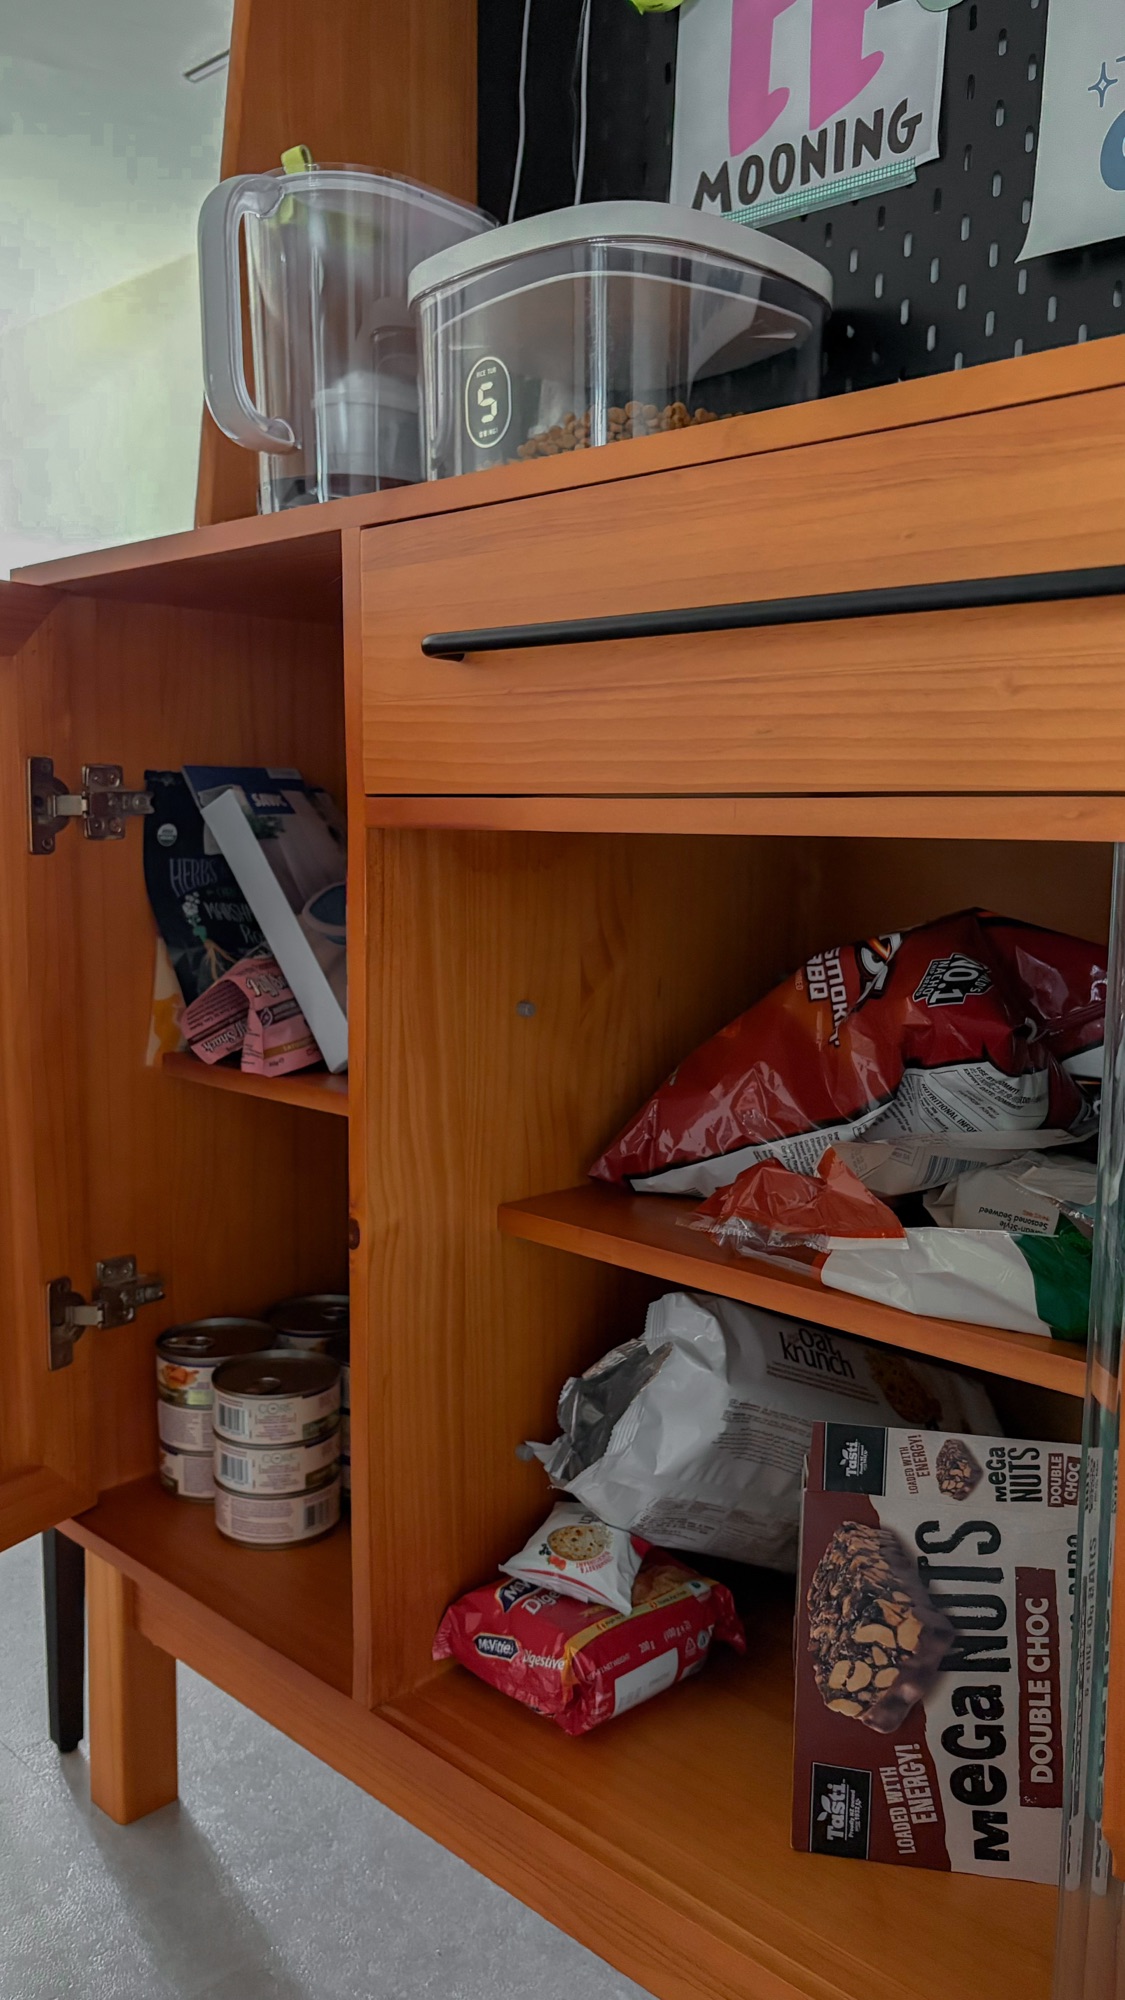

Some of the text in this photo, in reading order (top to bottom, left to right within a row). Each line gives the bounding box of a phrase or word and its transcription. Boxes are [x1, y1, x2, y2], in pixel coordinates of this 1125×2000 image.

[692, 97, 923, 213] MOONING
[477, 381, 498, 423] 5
[169, 857, 218, 898] HERBS
[203, 901, 253, 922] MARSH
[922, 960, 951, 995] NACHO
[921, 1083, 959, 1121] NUTRITIONAL
[978, 1206, 1013, 1222] Seaweed
[1013, 1215, 1049, 1231] Seasoned
[779, 1331, 856, 1380] krunch
[845, 1440, 859, 1477] Tasti
[899, 1446, 919, 1495] LOADED WITH
[907, 1434, 931, 1478] ENERGY!
[1007, 1447, 1043, 1503] NUTS
[1050, 1455, 1063, 1505] DOUBLE
[1063, 1462, 1081, 1501] CHOC
[915, 1519, 1012, 1673] NUTS
[522, 1649, 565, 1670] Digestive
[1025, 1597, 1054, 1784] DOUBLE CHOC
[894, 1743, 938, 1824] ENERGY!
[826, 1782, 846, 1841] Tasti
[879, 1766, 917, 1855] LOADED WITH
